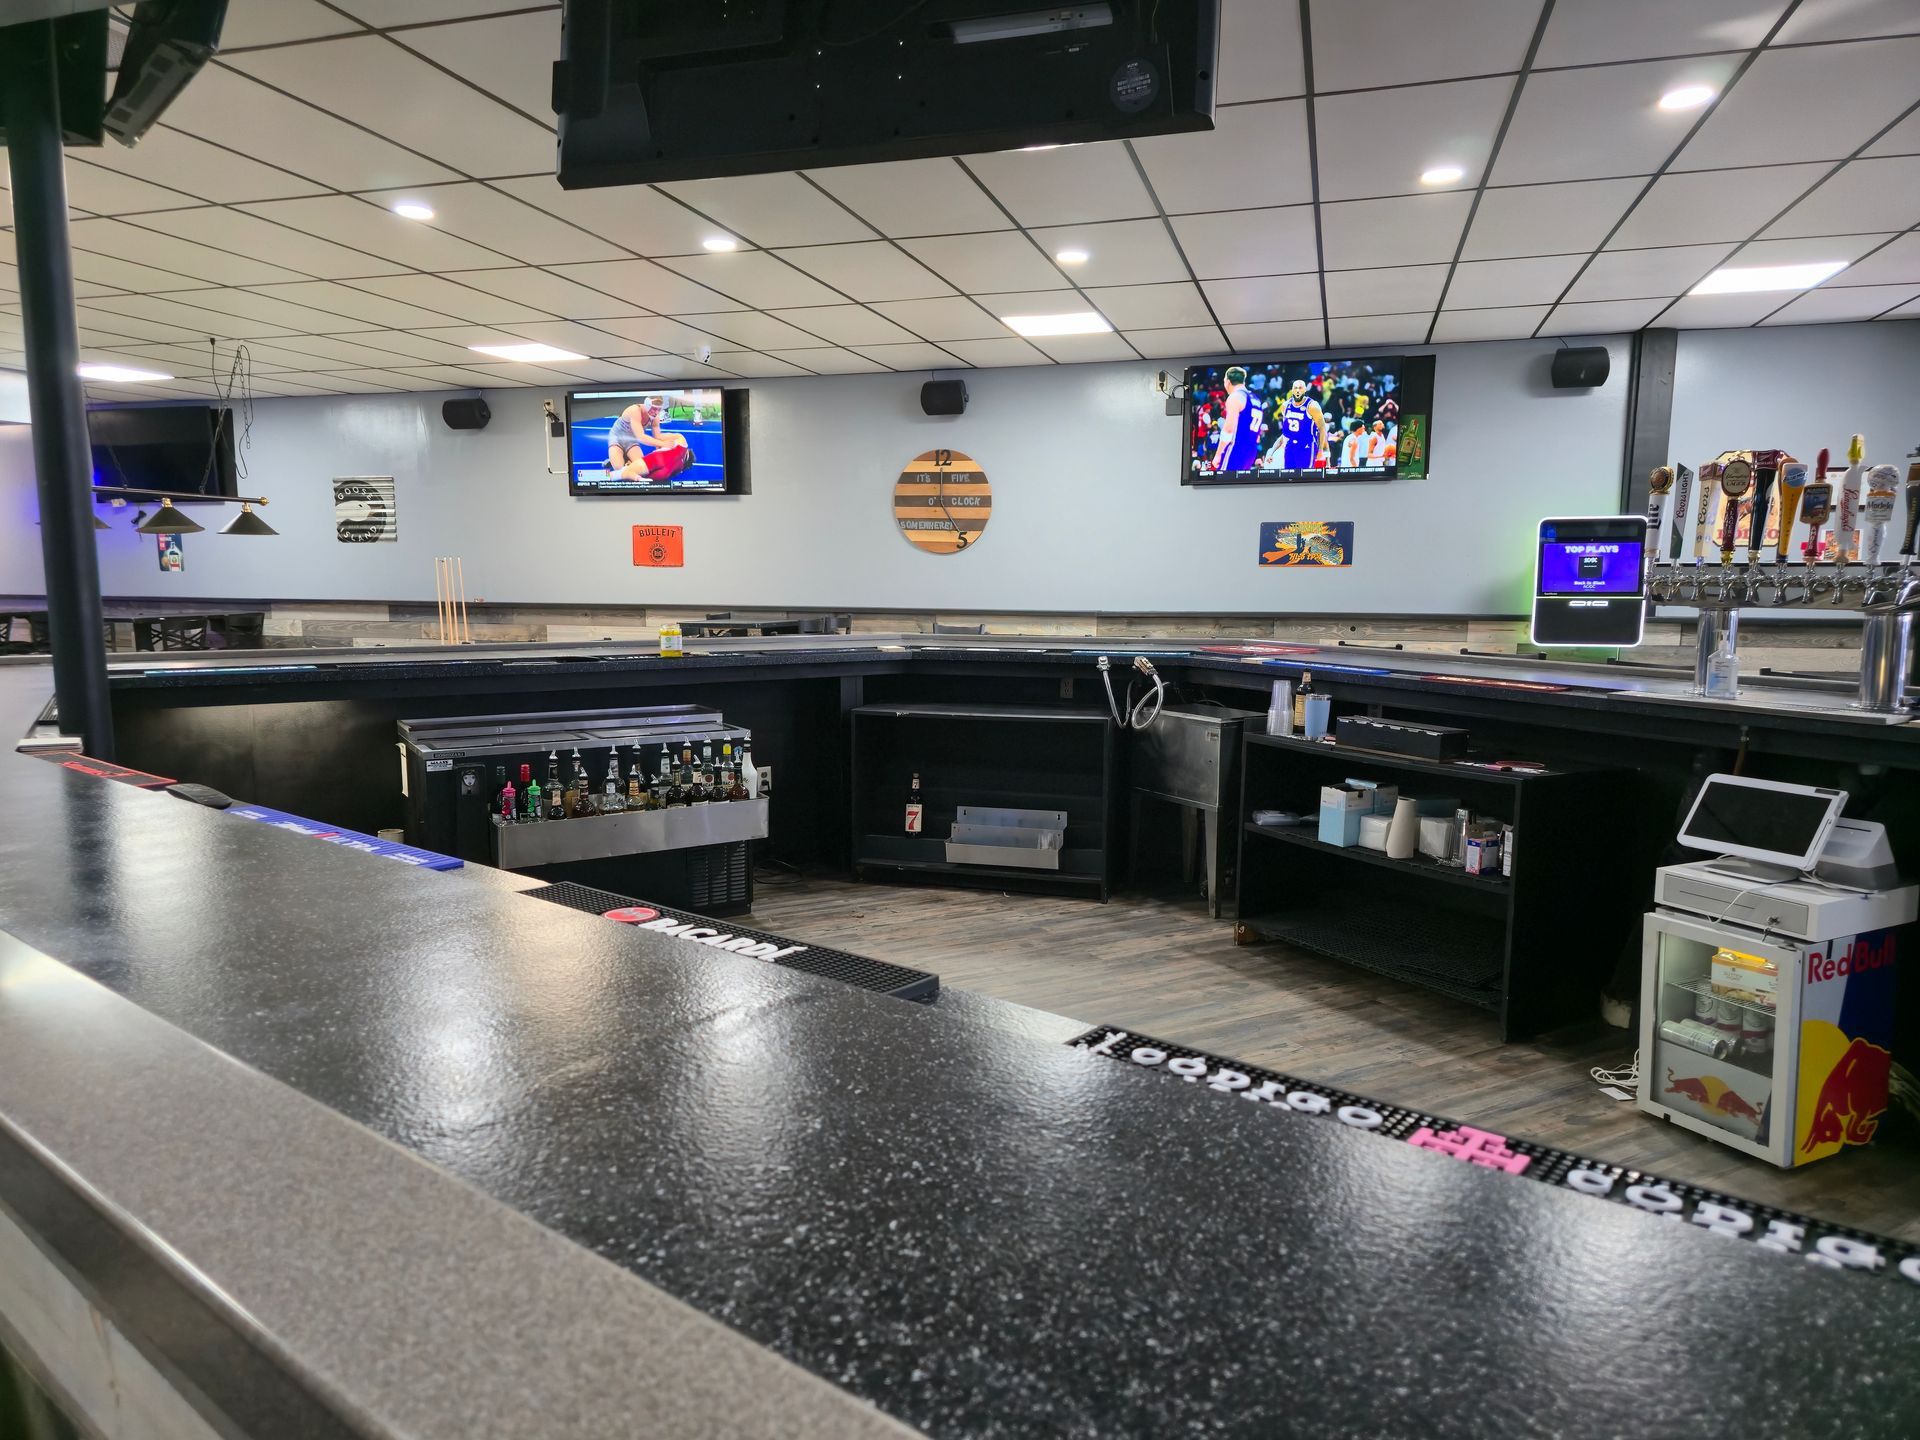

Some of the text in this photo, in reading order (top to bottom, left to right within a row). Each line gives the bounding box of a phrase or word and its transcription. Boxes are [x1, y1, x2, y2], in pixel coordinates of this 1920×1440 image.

[934, 449, 952, 466] 12
[951, 473, 970, 482] FIVE
[1680, 472, 1690, 495] LIGHT
[337, 486, 374, 501] GOOSE
[951, 497, 980, 506] CLOCK
[1867, 501, 1894, 513] Modelo
[340, 526, 377, 542] ISLAND
[639, 528, 676, 538] BULLEIT
[956, 532, 967, 549] 5
[1565, 545, 1619, 554] TOP PLAYS
[907, 811, 919, 830] 7
[1807, 934, 1896, 984] Red Bull
